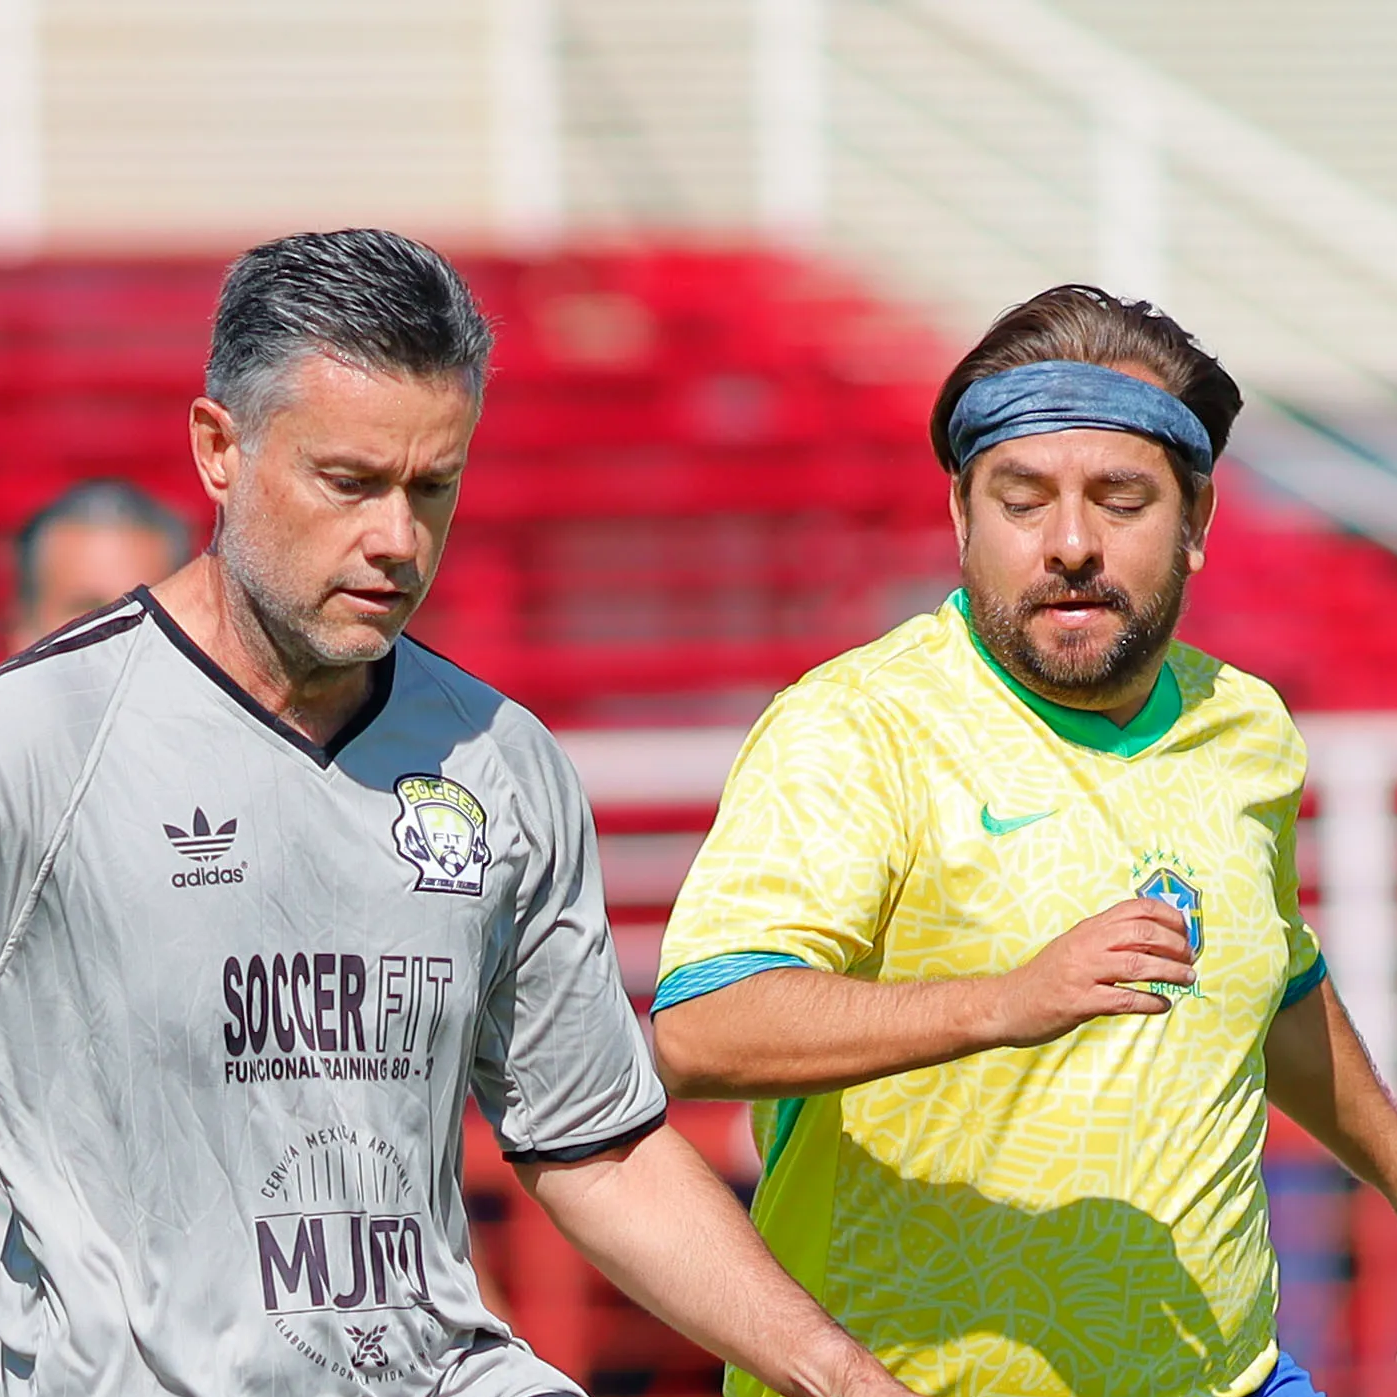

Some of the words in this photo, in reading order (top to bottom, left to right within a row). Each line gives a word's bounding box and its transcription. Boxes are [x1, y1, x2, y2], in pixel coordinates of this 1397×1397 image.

[399, 779, 484, 829] SOCCER
[433, 832, 463, 845] FIT
[172, 865, 244, 888] adidas
[223, 952, 366, 1057] SOCCER
[376, 955, 453, 1054] FIT
[225, 1056, 320, 1084] FUNCIONAL
[319, 1056, 387, 1081] RAINING
[391, 1057, 410, 1080] 80
[274, 1318, 327, 1367] ELABORADA
[377, 1369, 404, 1383] VIDA
